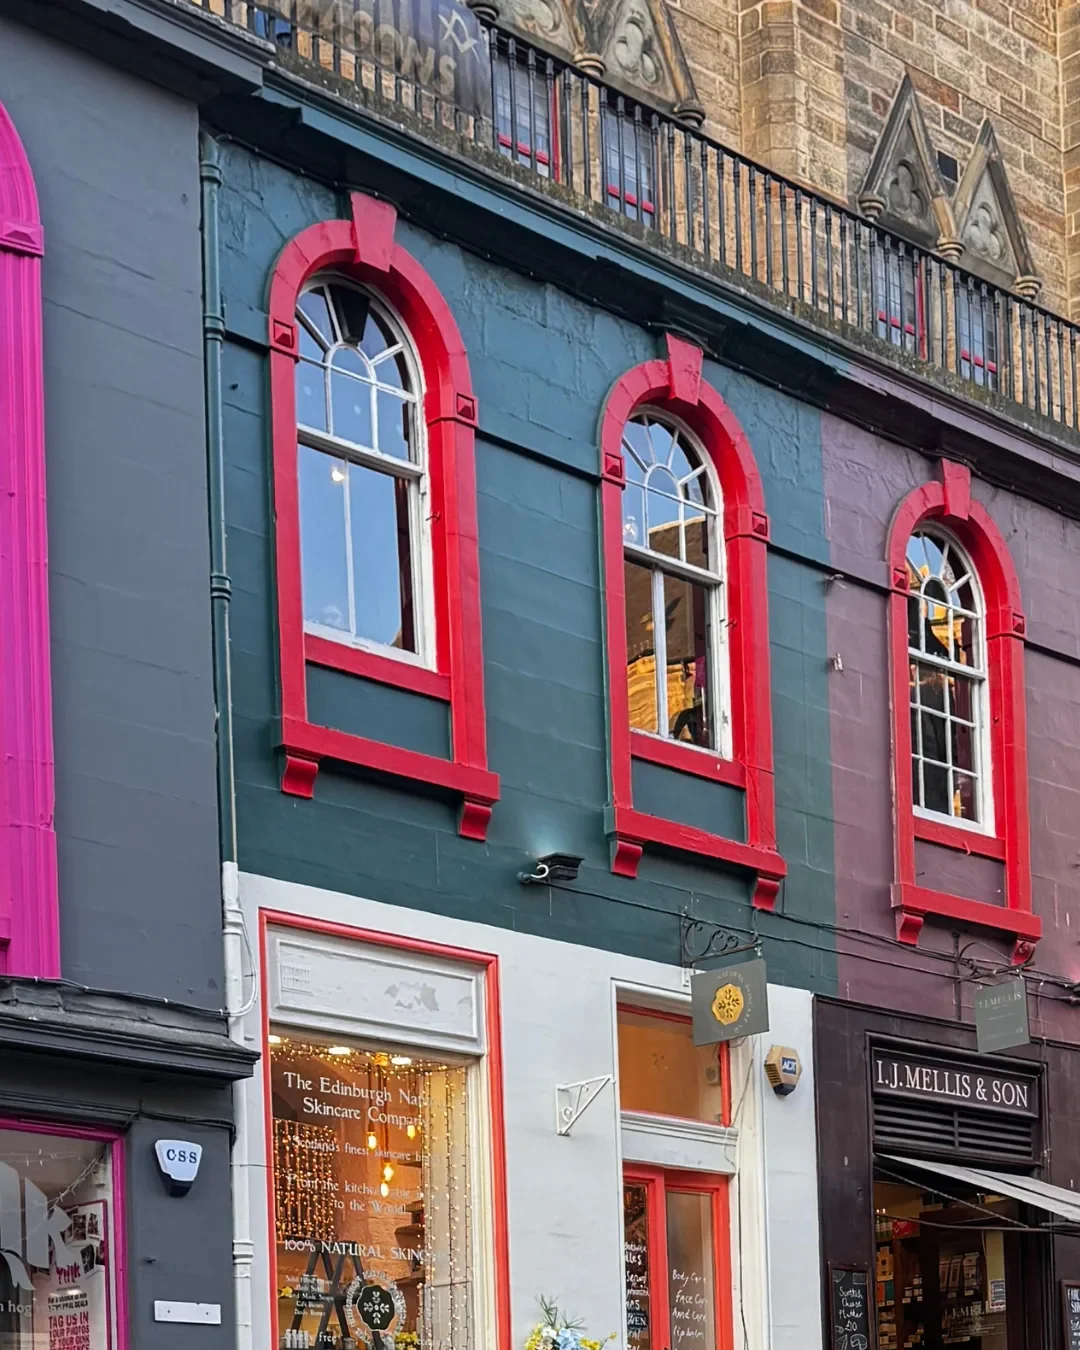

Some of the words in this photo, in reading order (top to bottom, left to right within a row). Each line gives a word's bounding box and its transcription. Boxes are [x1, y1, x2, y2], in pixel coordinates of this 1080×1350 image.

[283, 1071, 313, 1090] The
[320, 1077, 392, 1107] Edinburgh
[976, 1077, 988, 1101] &
[992, 1080, 1028, 1107] SON
[303, 1096, 361, 1120] Skincare
[374, 1152, 411, 1162] skincare
[334, 1200, 344, 1209] to
[350, 1199, 365, 1211] the
[284, 1239, 316, 1252] 100%
[321, 1241, 385, 1259] NATURAL
[672, 1268, 689, 1287] Body
[48, 1314, 64, 1329] TAG
[66, 1312, 77, 1326] US
[79, 1311, 89, 1324] IN
[48, 1329, 65, 1339] YOUR
[66, 1325, 90, 1336] PHOTOS
[49, 1339, 57, 1348] OF
[58, 1336, 74, 1346] YOUR
